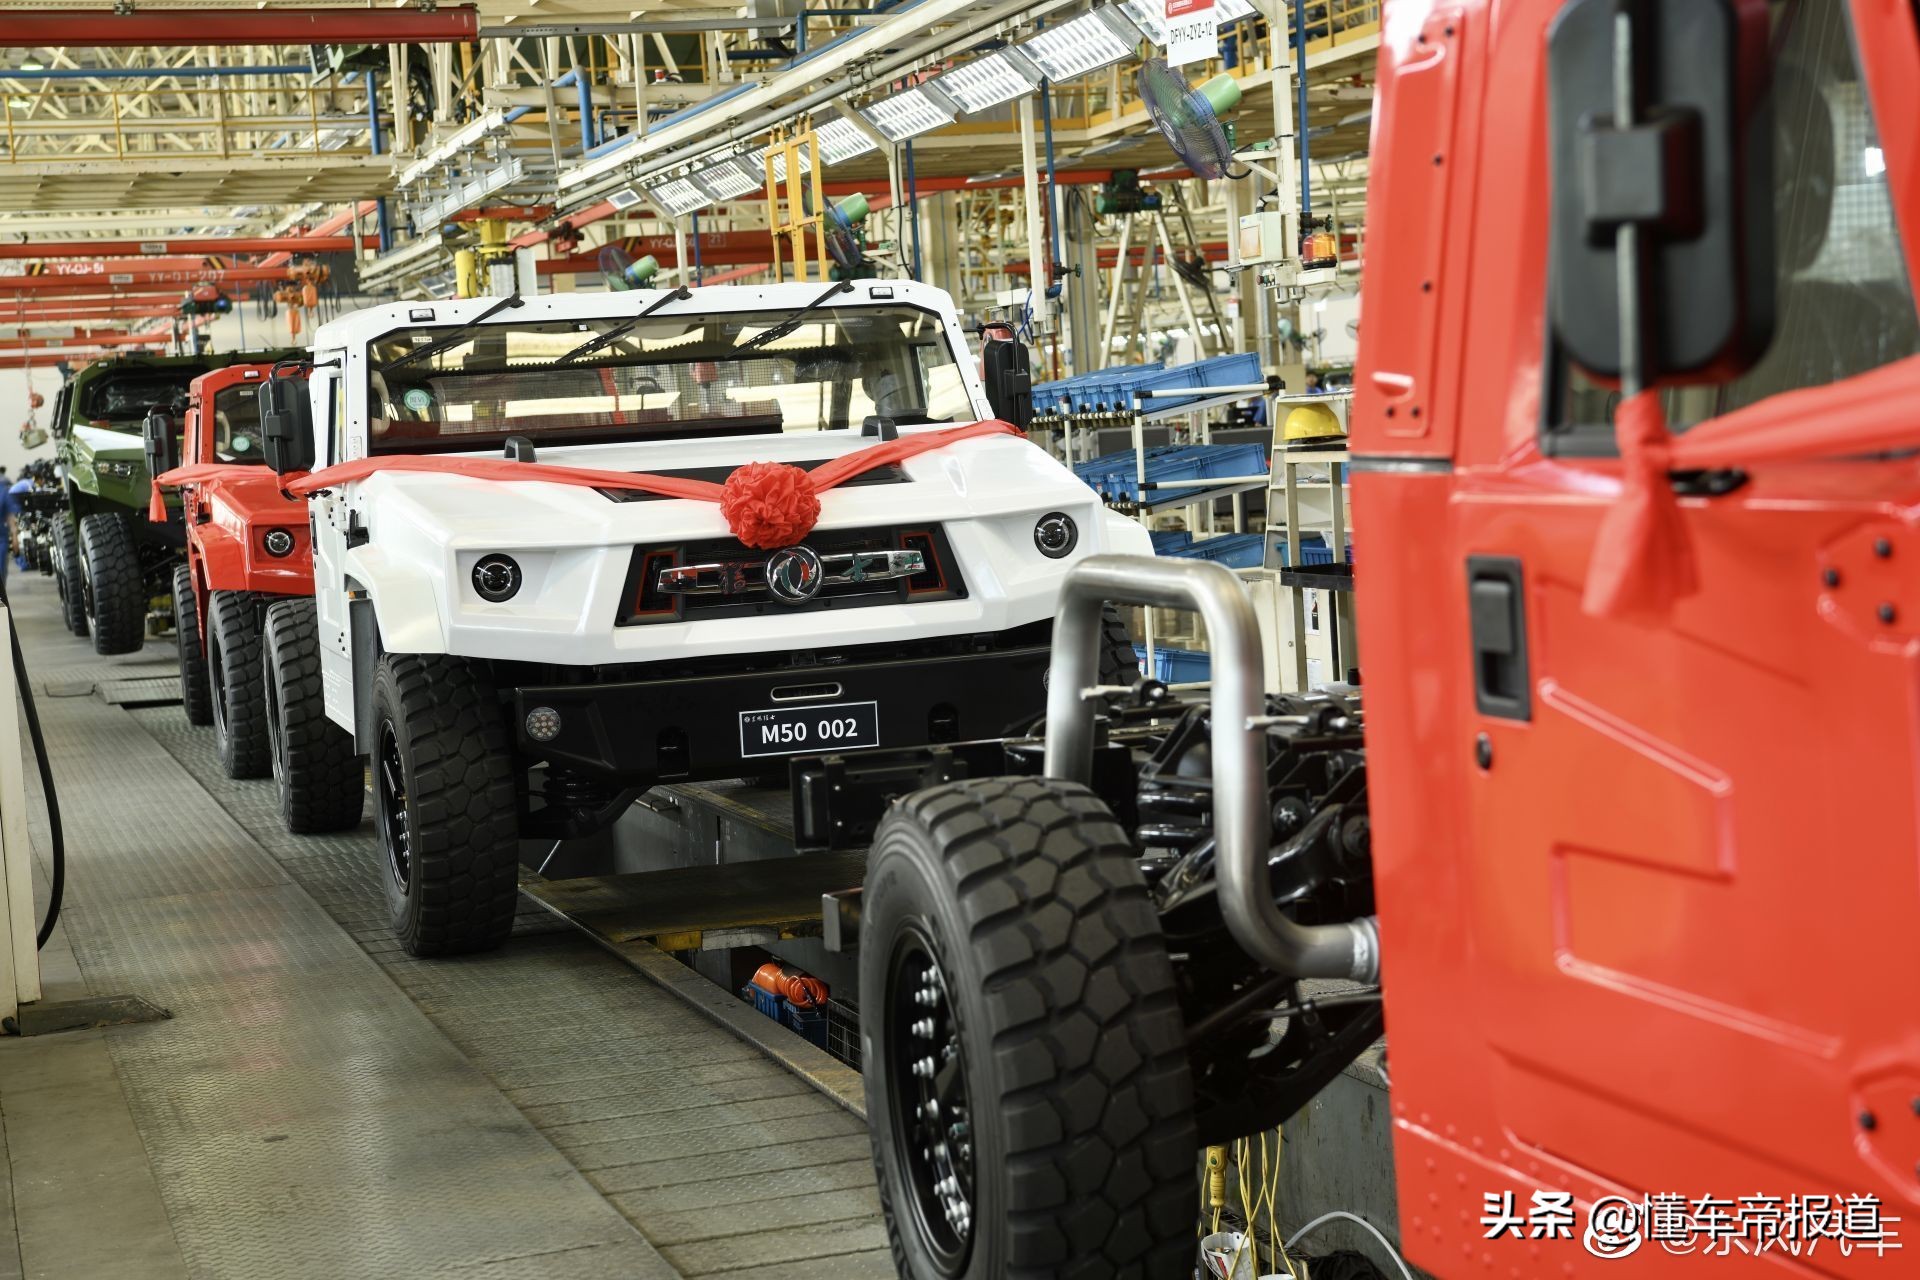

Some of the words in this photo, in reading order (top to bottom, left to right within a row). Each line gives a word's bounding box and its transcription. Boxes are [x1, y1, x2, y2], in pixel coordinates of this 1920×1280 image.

[1170, 20, 1213, 45] DFYY-ZYZ-12
[761, 722, 807, 744] M50
[817, 718, 858, 740] 002
